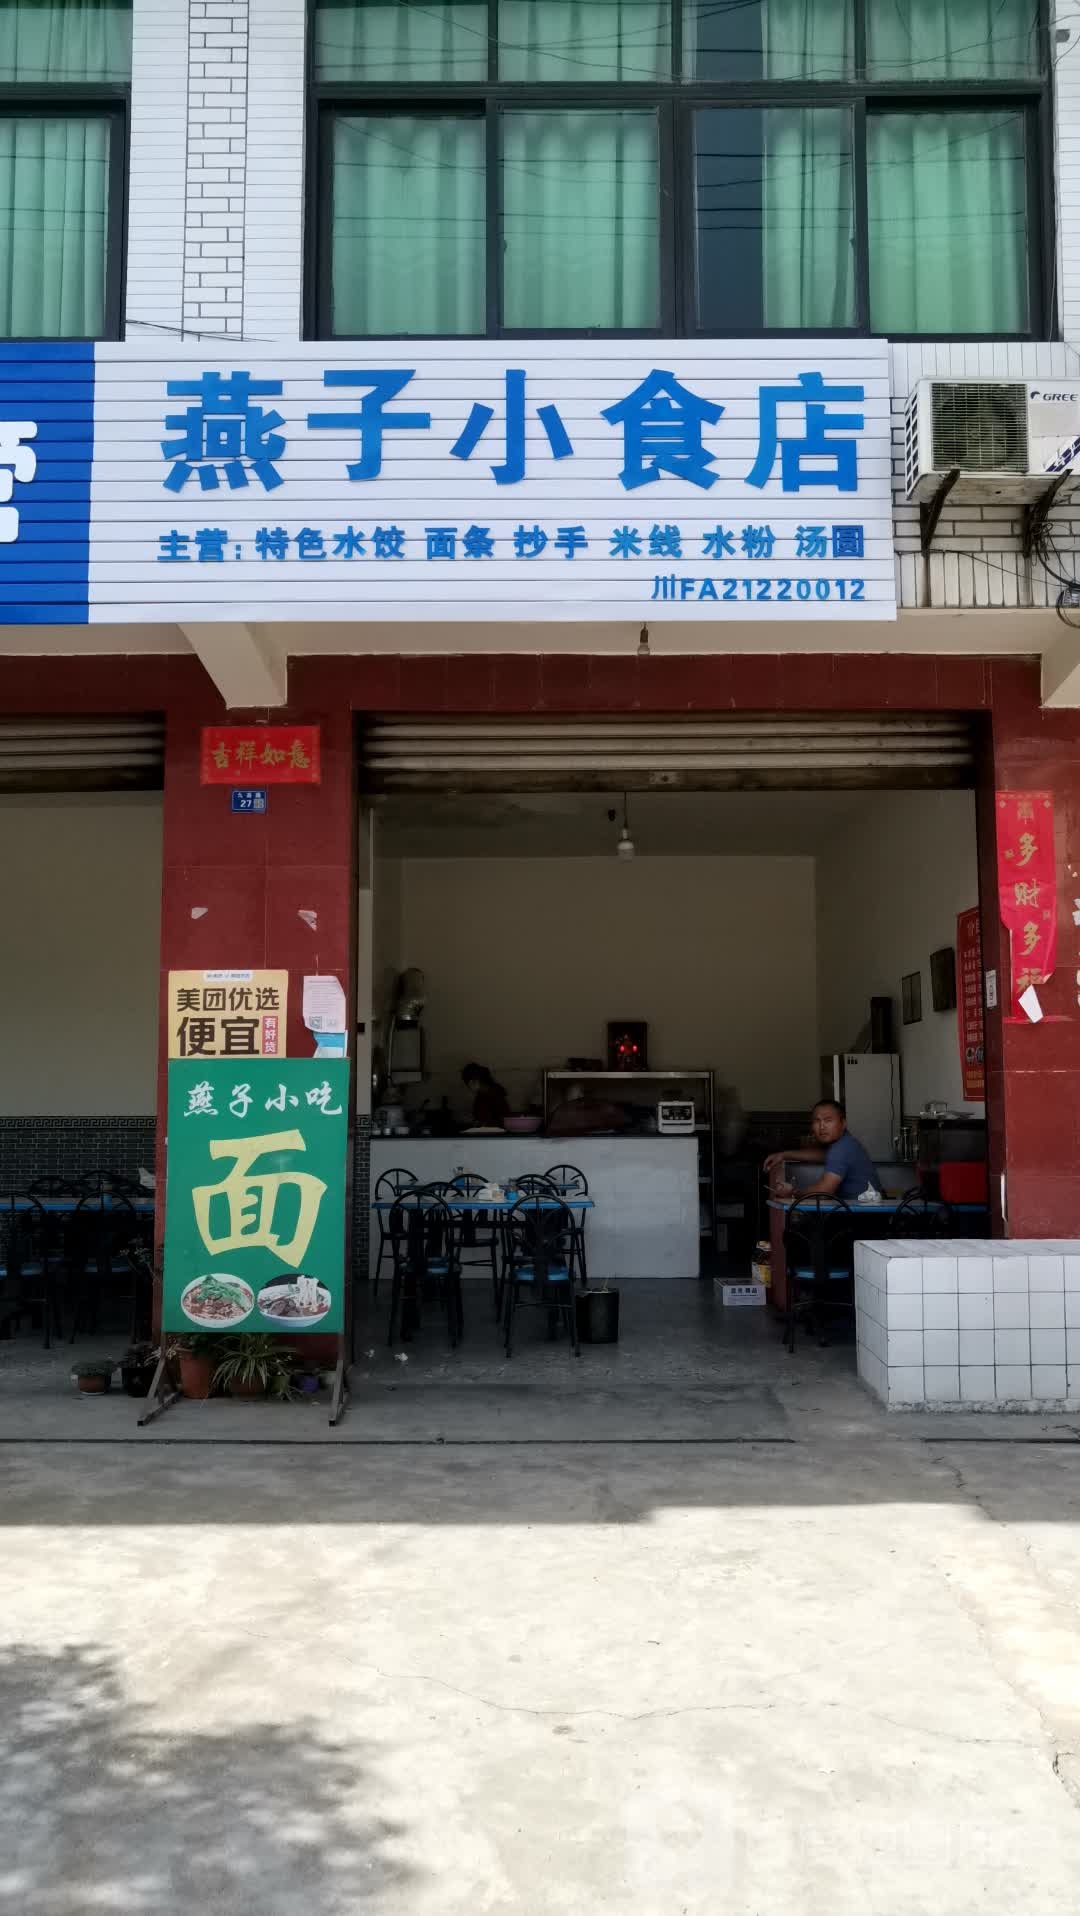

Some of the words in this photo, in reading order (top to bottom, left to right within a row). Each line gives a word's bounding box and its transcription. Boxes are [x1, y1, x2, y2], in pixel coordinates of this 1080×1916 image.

[1043, 393, 1079, 402] GREE
[160, 368, 864, 493] 燕子小食店
[425, 526, 494, 560] 面条
[513, 525, 588, 559] 抄手
[609, 525, 682, 559] 米线
[702, 525, 776, 559] 水粉
[651, 574, 865, 601] 川FA21220012
[211, 740, 312, 769] 吉祥如意
[240, 799, 252, 808] 27
[176, 987, 280, 1012] 美团优选
[176, 1016, 260, 1056] 便宜
[264, 1017, 277, 1053] 有好货
[183, 1080, 343, 1118] 燕子小吃
[191, 1128, 328, 1269] 面
